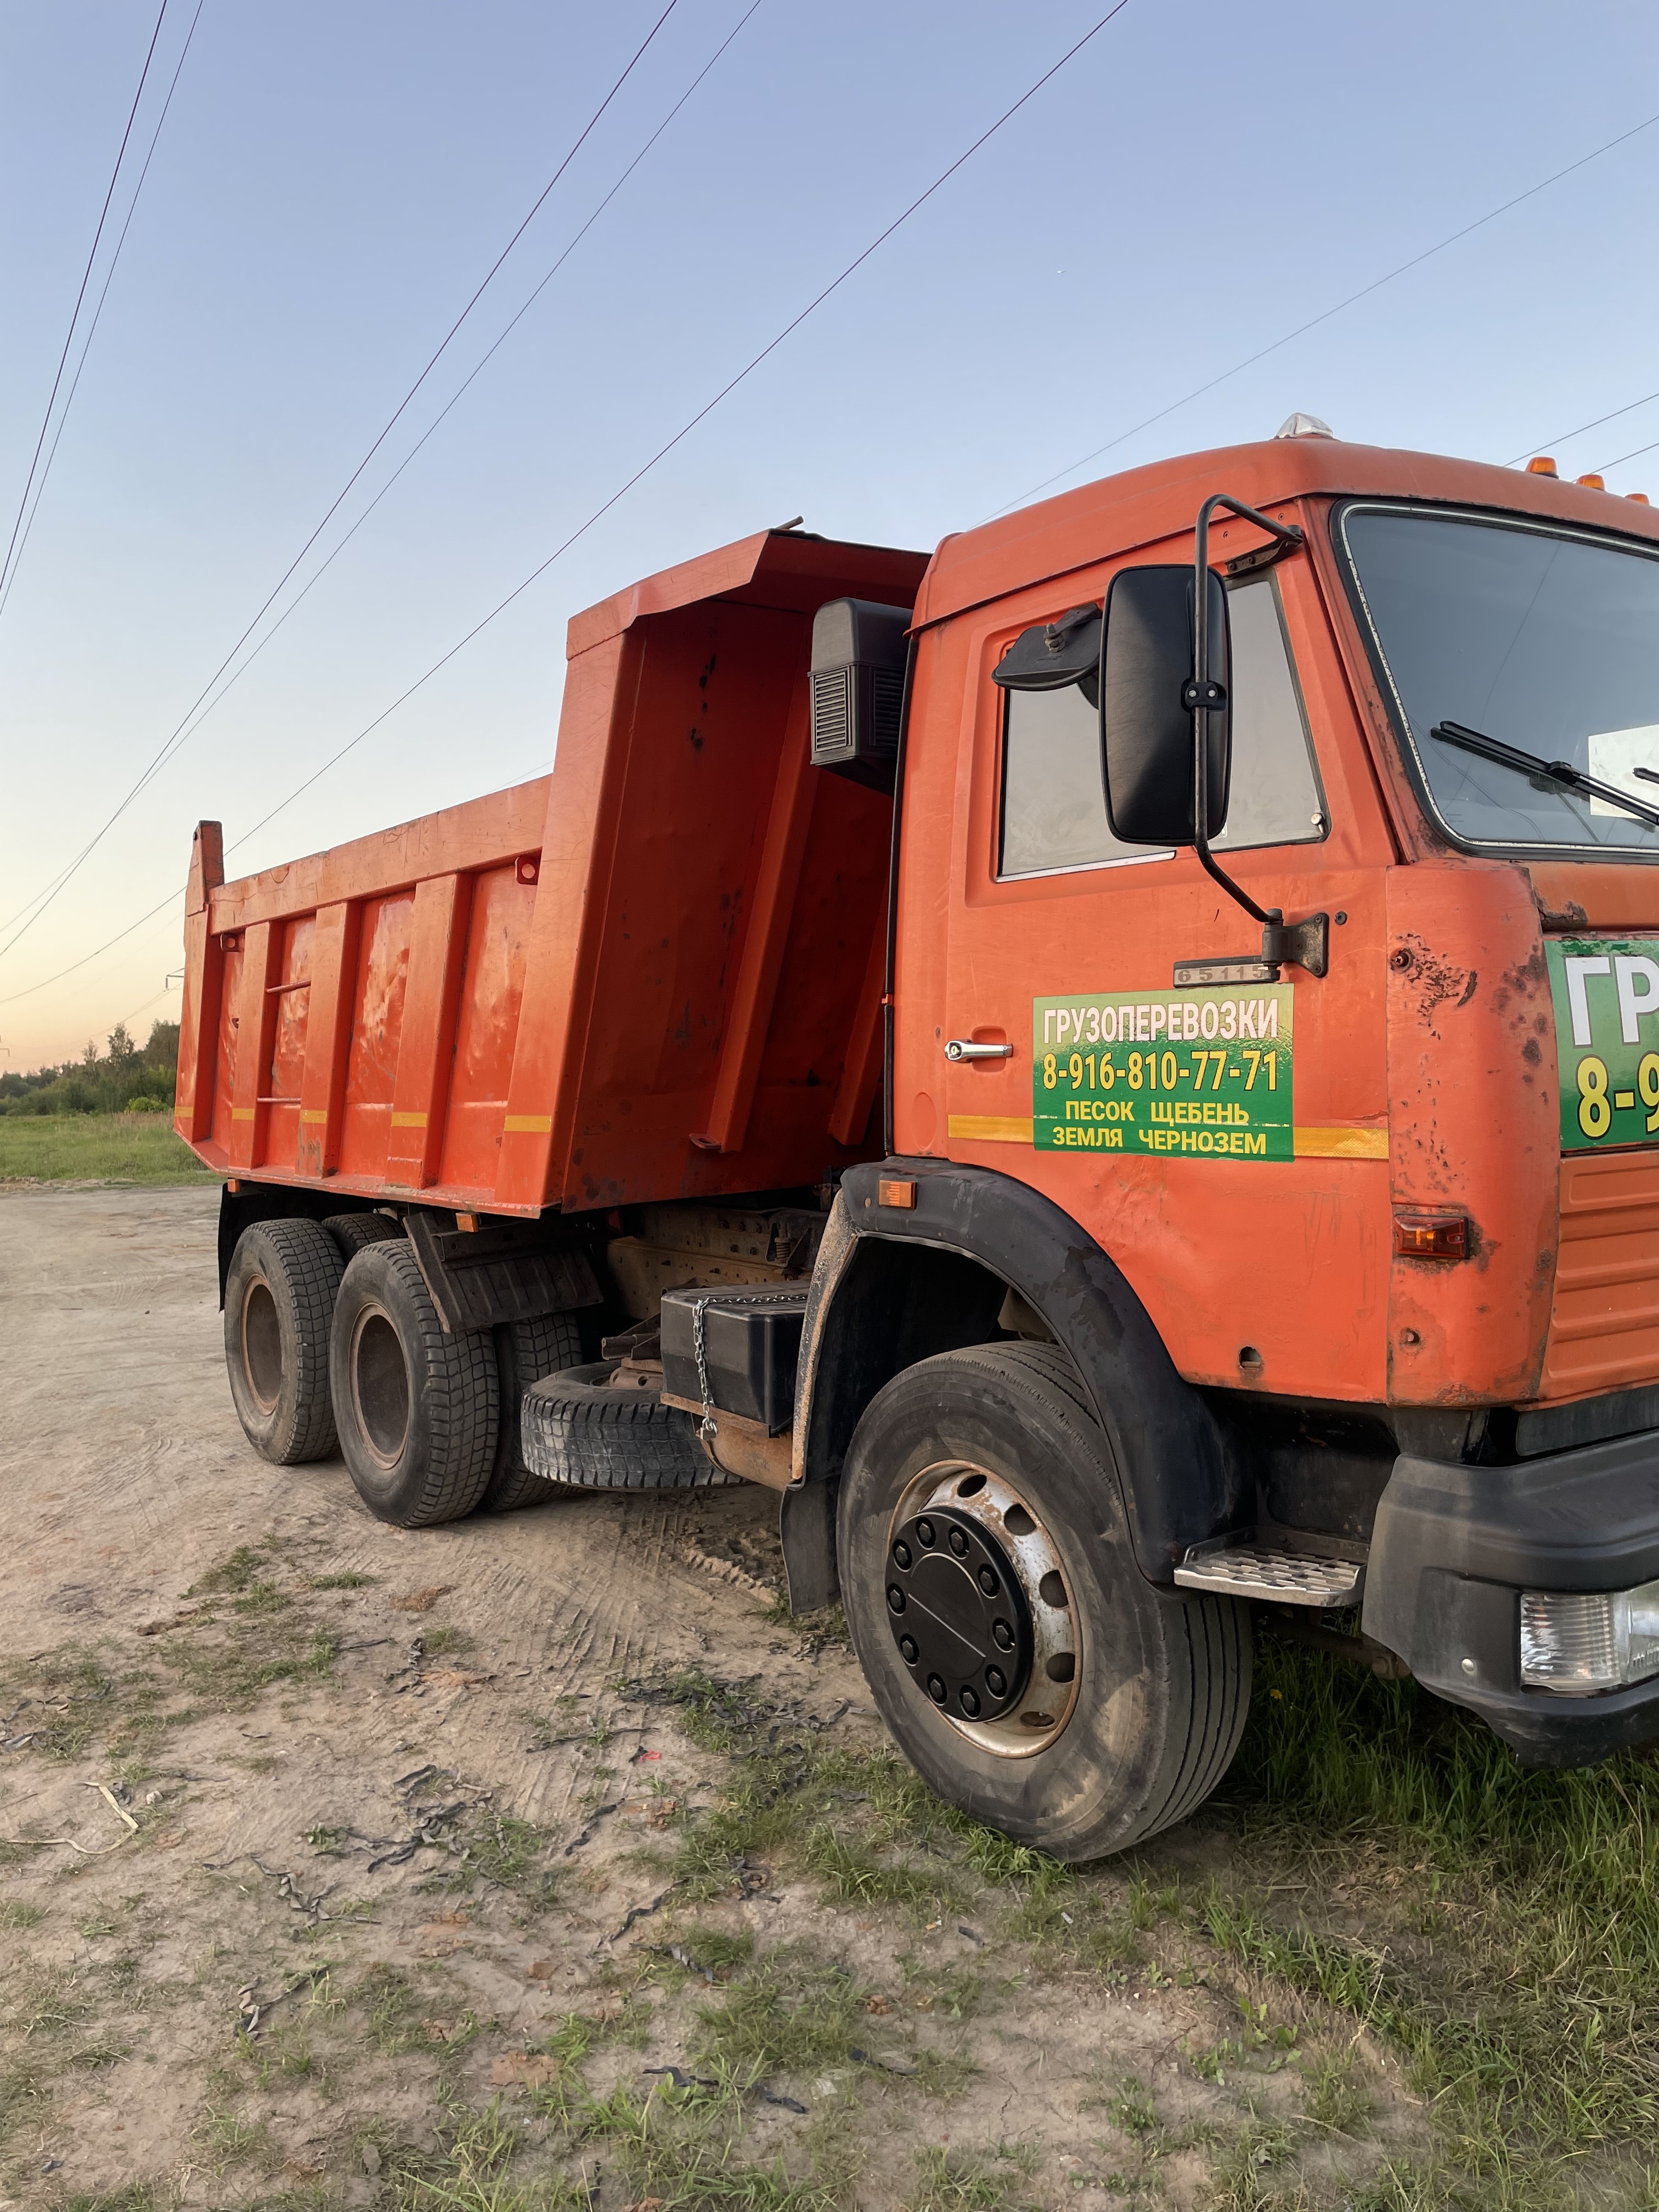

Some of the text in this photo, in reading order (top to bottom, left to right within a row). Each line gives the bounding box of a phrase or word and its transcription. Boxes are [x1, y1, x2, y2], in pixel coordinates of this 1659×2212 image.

[1178, 965, 1263, 983] 65115
[1565, 956, 1659, 1046] ГР
[1044, 998, 1278, 1043] ГРУЗОПЕРЕВОЗКИ
[1042, 1050, 1277, 1091] 8-916-810-77-71
[1065, 1101, 1249, 1126] ПЕСОК ЩЕБЕНЬ
[1053, 1126, 1267, 1155] ЗЕМЛЯ ЧЕРНОЗЕМ
